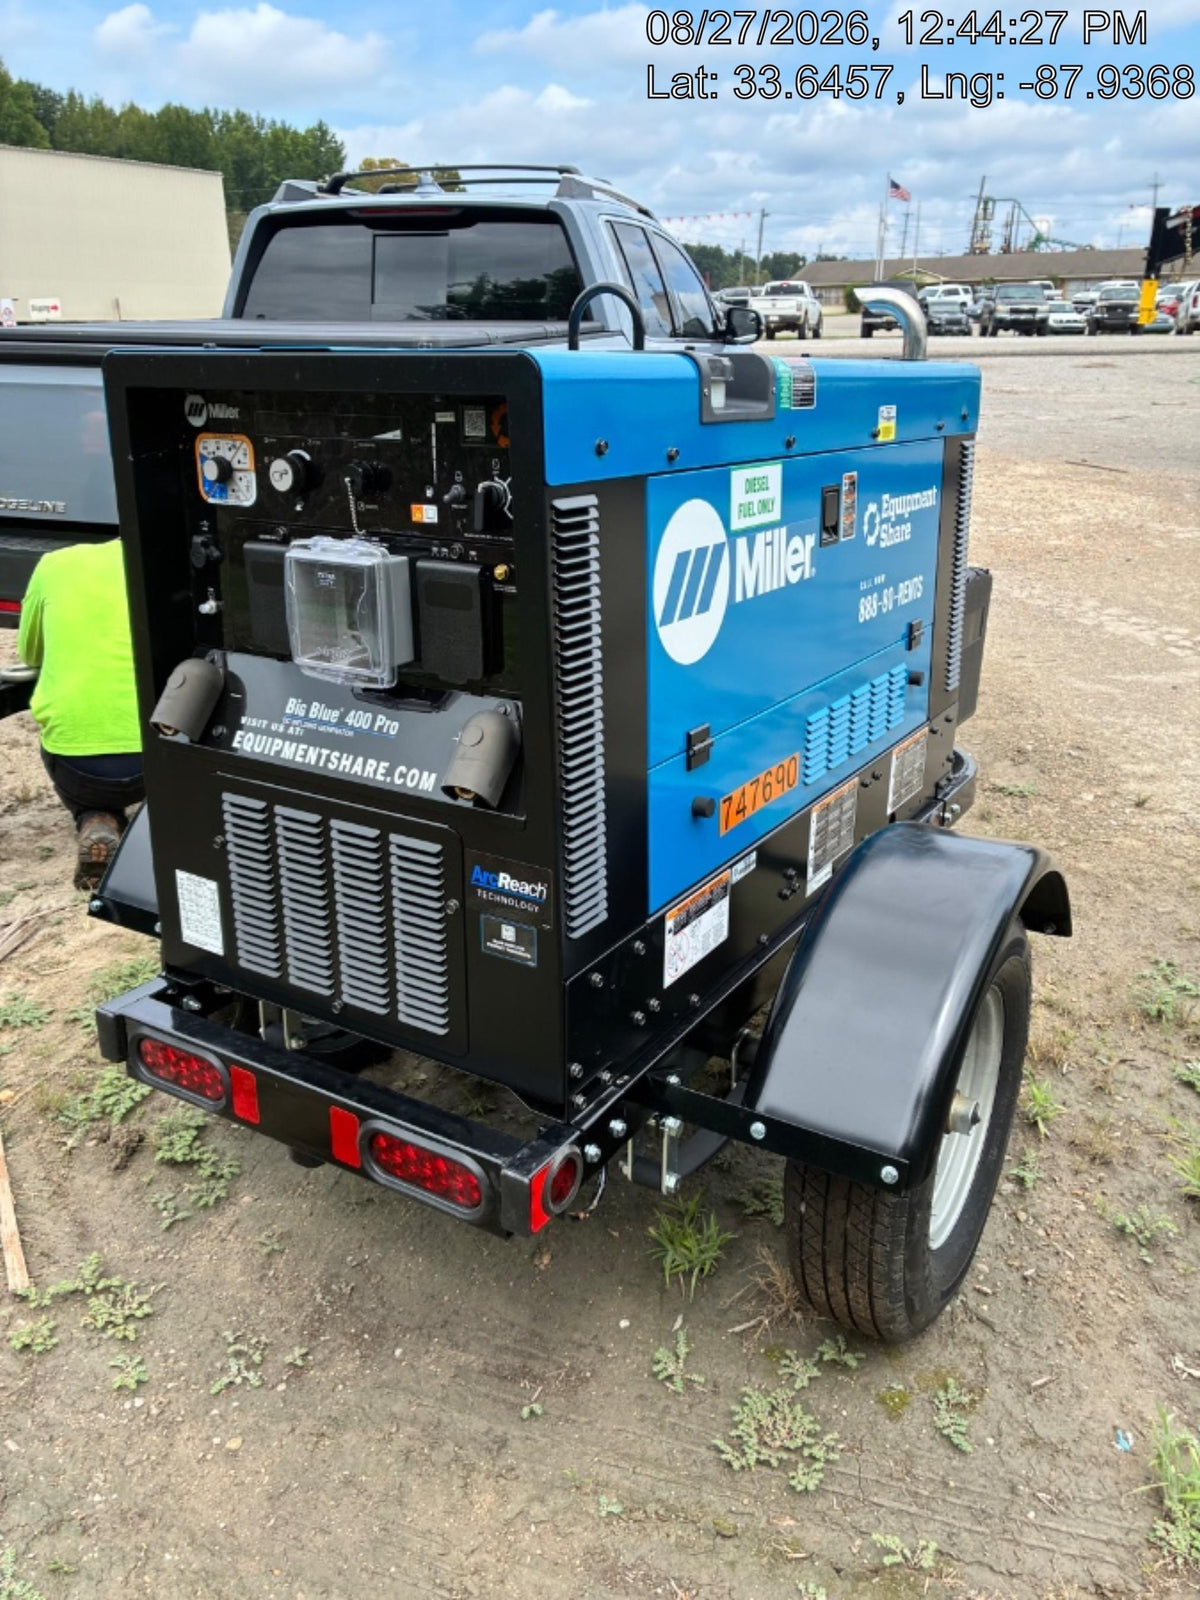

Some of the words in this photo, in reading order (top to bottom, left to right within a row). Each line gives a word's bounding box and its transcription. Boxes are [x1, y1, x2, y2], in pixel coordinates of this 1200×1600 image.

[208, 402, 240, 419] Miller
[744, 476, 770, 495] DIESEL
[737, 501, 757, 520] FUEL
[757, 496, 776, 516] ONLY
[881, 485, 938, 518] Equipment
[879, 522, 912, 549] Share
[735, 526, 817, 603] Miller
[240, 715, 268, 729] VISIT
[271, 721, 285, 733] US
[285, 697, 306, 718] Big
[345, 709, 372, 730] 400
[374, 713, 400, 735] Pro
[232, 729, 438, 793] EQUIPMENTSHARE.COM
[721, 754, 798, 831] 747690
[471, 864, 547, 900] ArcReach
[476, 888, 540, 913] TECHNOLOGY
